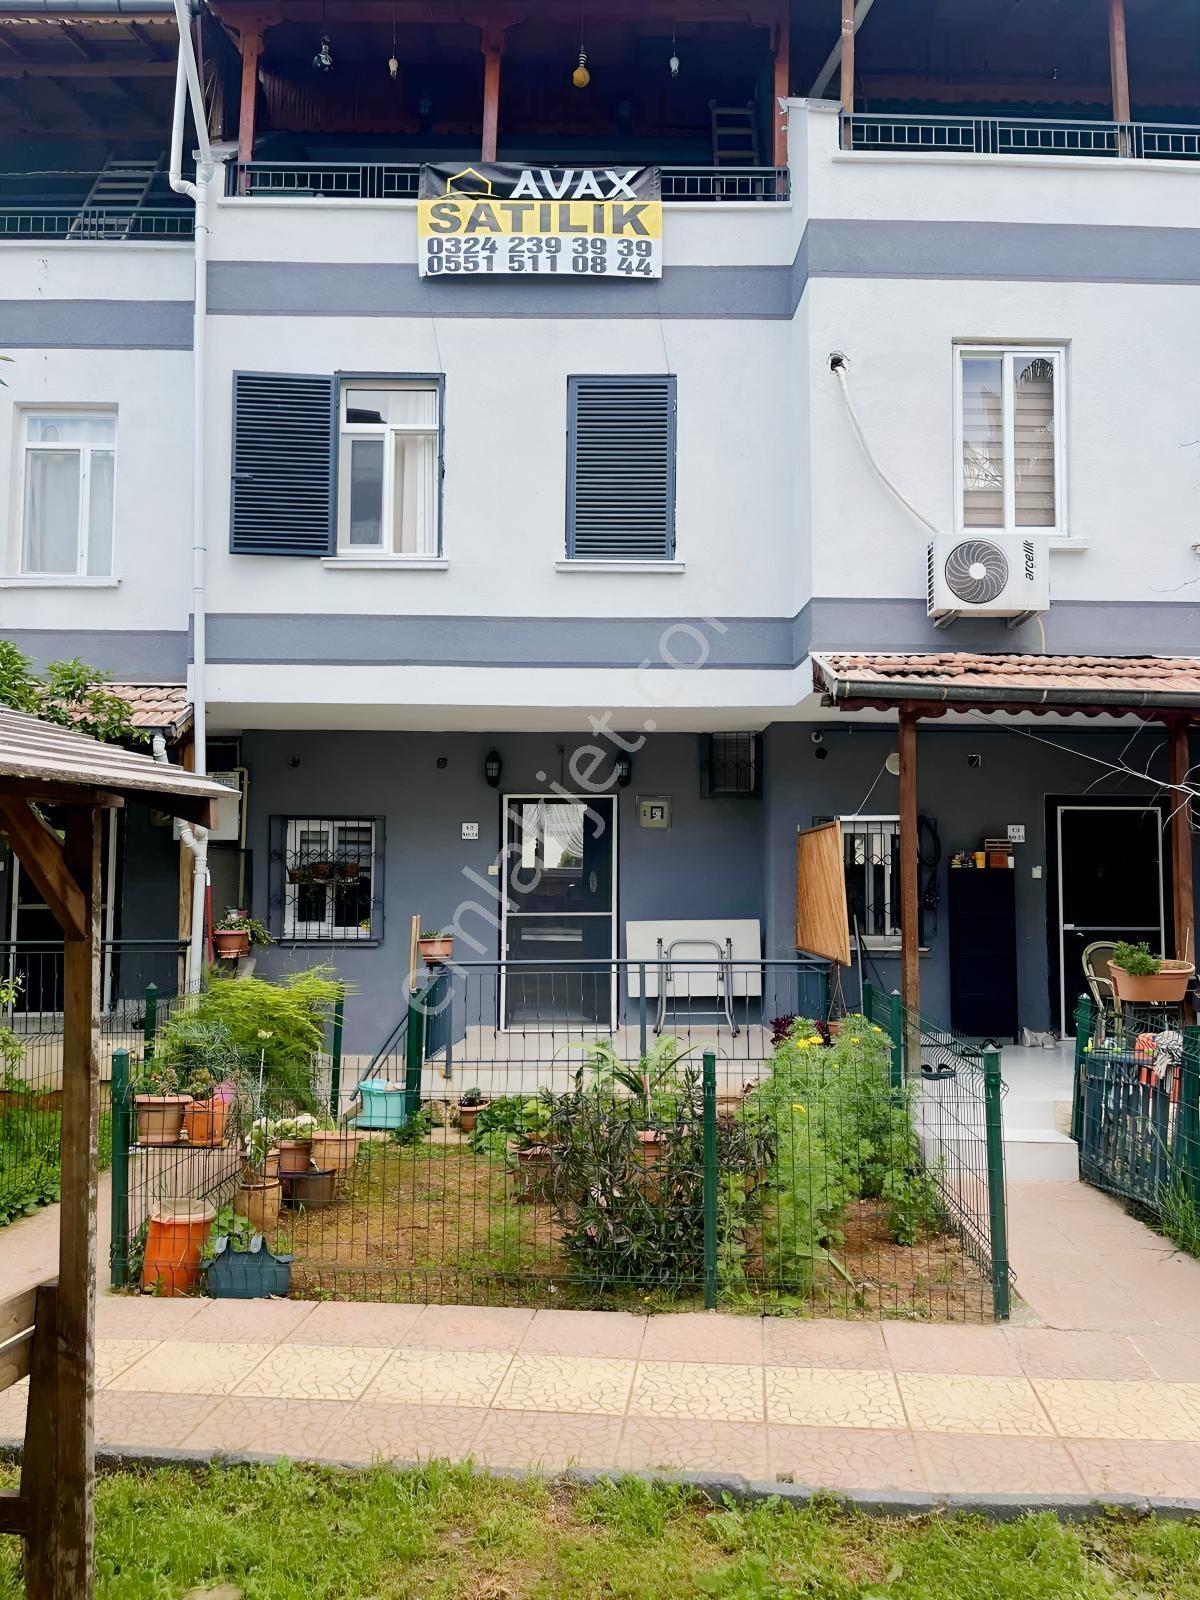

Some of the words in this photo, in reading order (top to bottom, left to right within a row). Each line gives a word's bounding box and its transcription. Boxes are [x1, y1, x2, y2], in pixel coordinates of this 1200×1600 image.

[508, 170, 640, 199] AVAX
[428, 203, 650, 236] SATILIK
[427, 237, 498, 254] 0324
[508, 237, 562, 254] 239
[572, 237, 607, 255] 39
[617, 239, 653, 257] 39
[427, 255, 494, 273] 0551
[508, 254, 558, 272] 511
[572, 255, 607, 273] 08
[616, 257, 653, 275] 44
